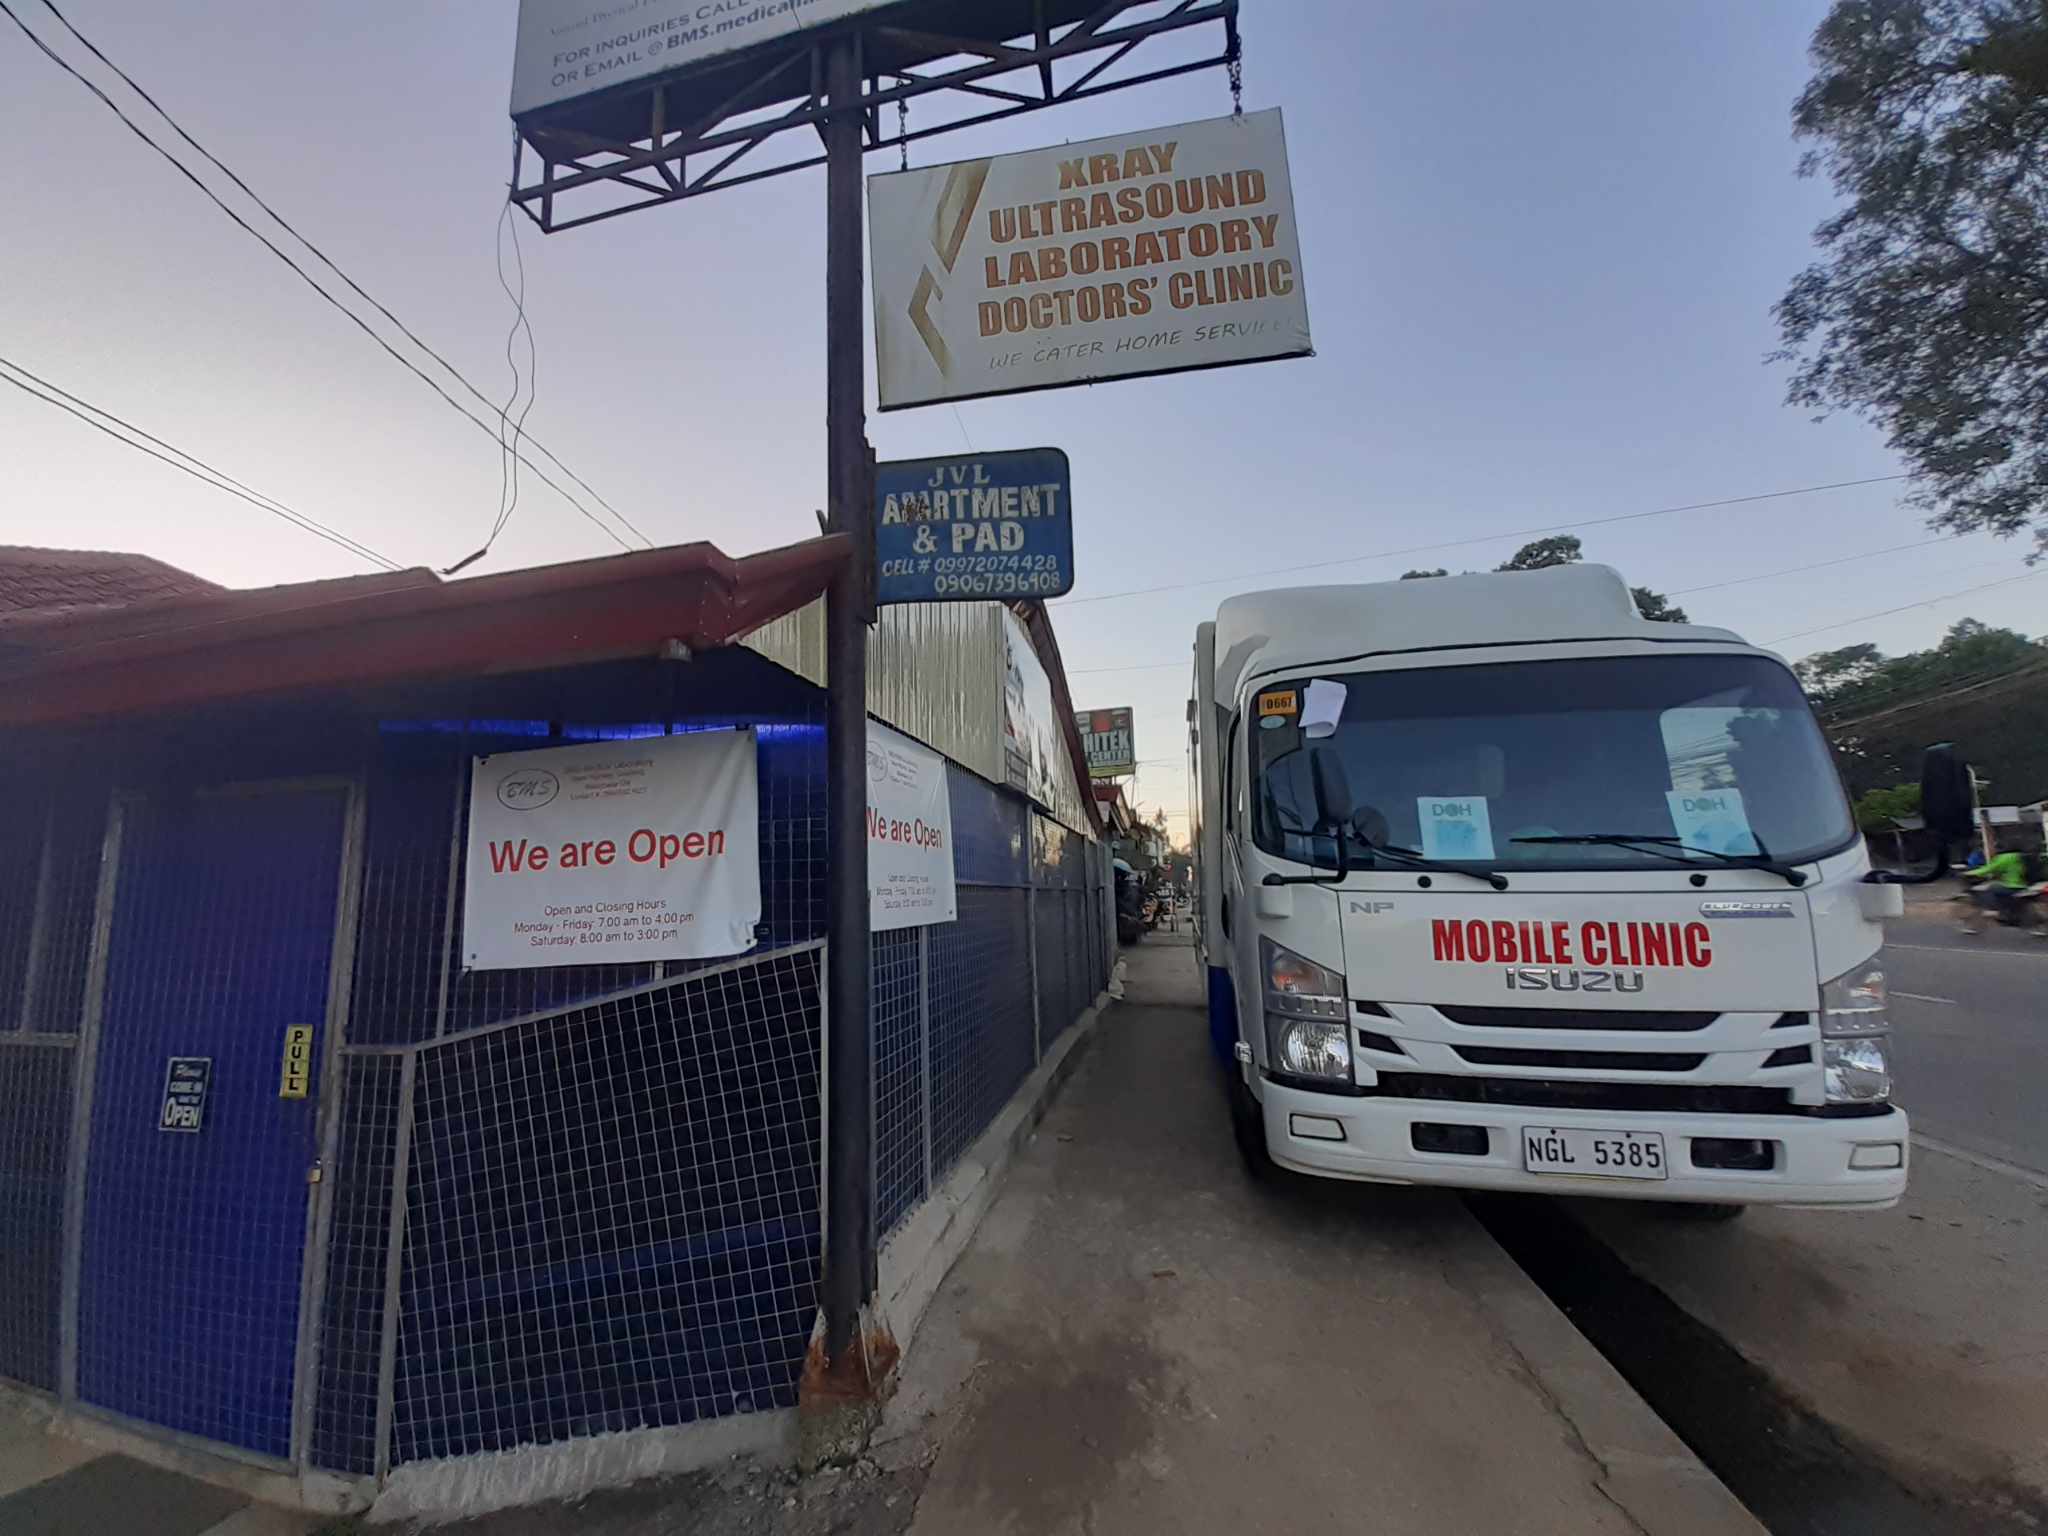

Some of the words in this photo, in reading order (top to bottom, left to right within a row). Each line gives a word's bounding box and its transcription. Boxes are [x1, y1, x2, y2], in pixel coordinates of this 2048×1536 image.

[552, 46, 591, 68] FOR
[595, 14, 690, 54] INQUIRIES
[551, 70, 579, 88] OR
[584, 51, 642, 78] EMAIL
[1058, 141, 1177, 190] XRAY
[989, 168, 1266, 244] ULTRASOUND
[985, 214, 1279, 289] LABORATORY
[1168, 258, 1294, 310] CLINIC
[989, 351, 1023, 370] WE
[1033, 340, 1104, 363] CATER
[1115, 330, 1181, 353] HOME
[882, 484, 1060, 525] APARTMENT
[912, 524, 938, 554] &
[951, 521, 1025, 553] PAD
[489, 838, 549, 873] We
[559, 839, 616, 868] are
[628, 828, 725, 869] Open
[890, 818, 912, 843] are
[914, 817, 942, 853] Open
[513, 921, 553, 934] Monday
[641, 914, 653, 926] to
[544, 904, 572, 917] Open
[574, 903, 593, 914] and
[595, 901, 634, 914] Closing
[636, 899, 666, 912] Hours
[1349, 901, 1395, 914] NP
[623, 931, 634, 942] to
[1432, 918, 1573, 966] MOBILE
[1582, 920, 1713, 968] CLINIC
[288, 1030, 304, 1092] PULL
[1528, 1136, 1576, 1164] NGL
[1594, 1140, 1661, 1168] 5385
